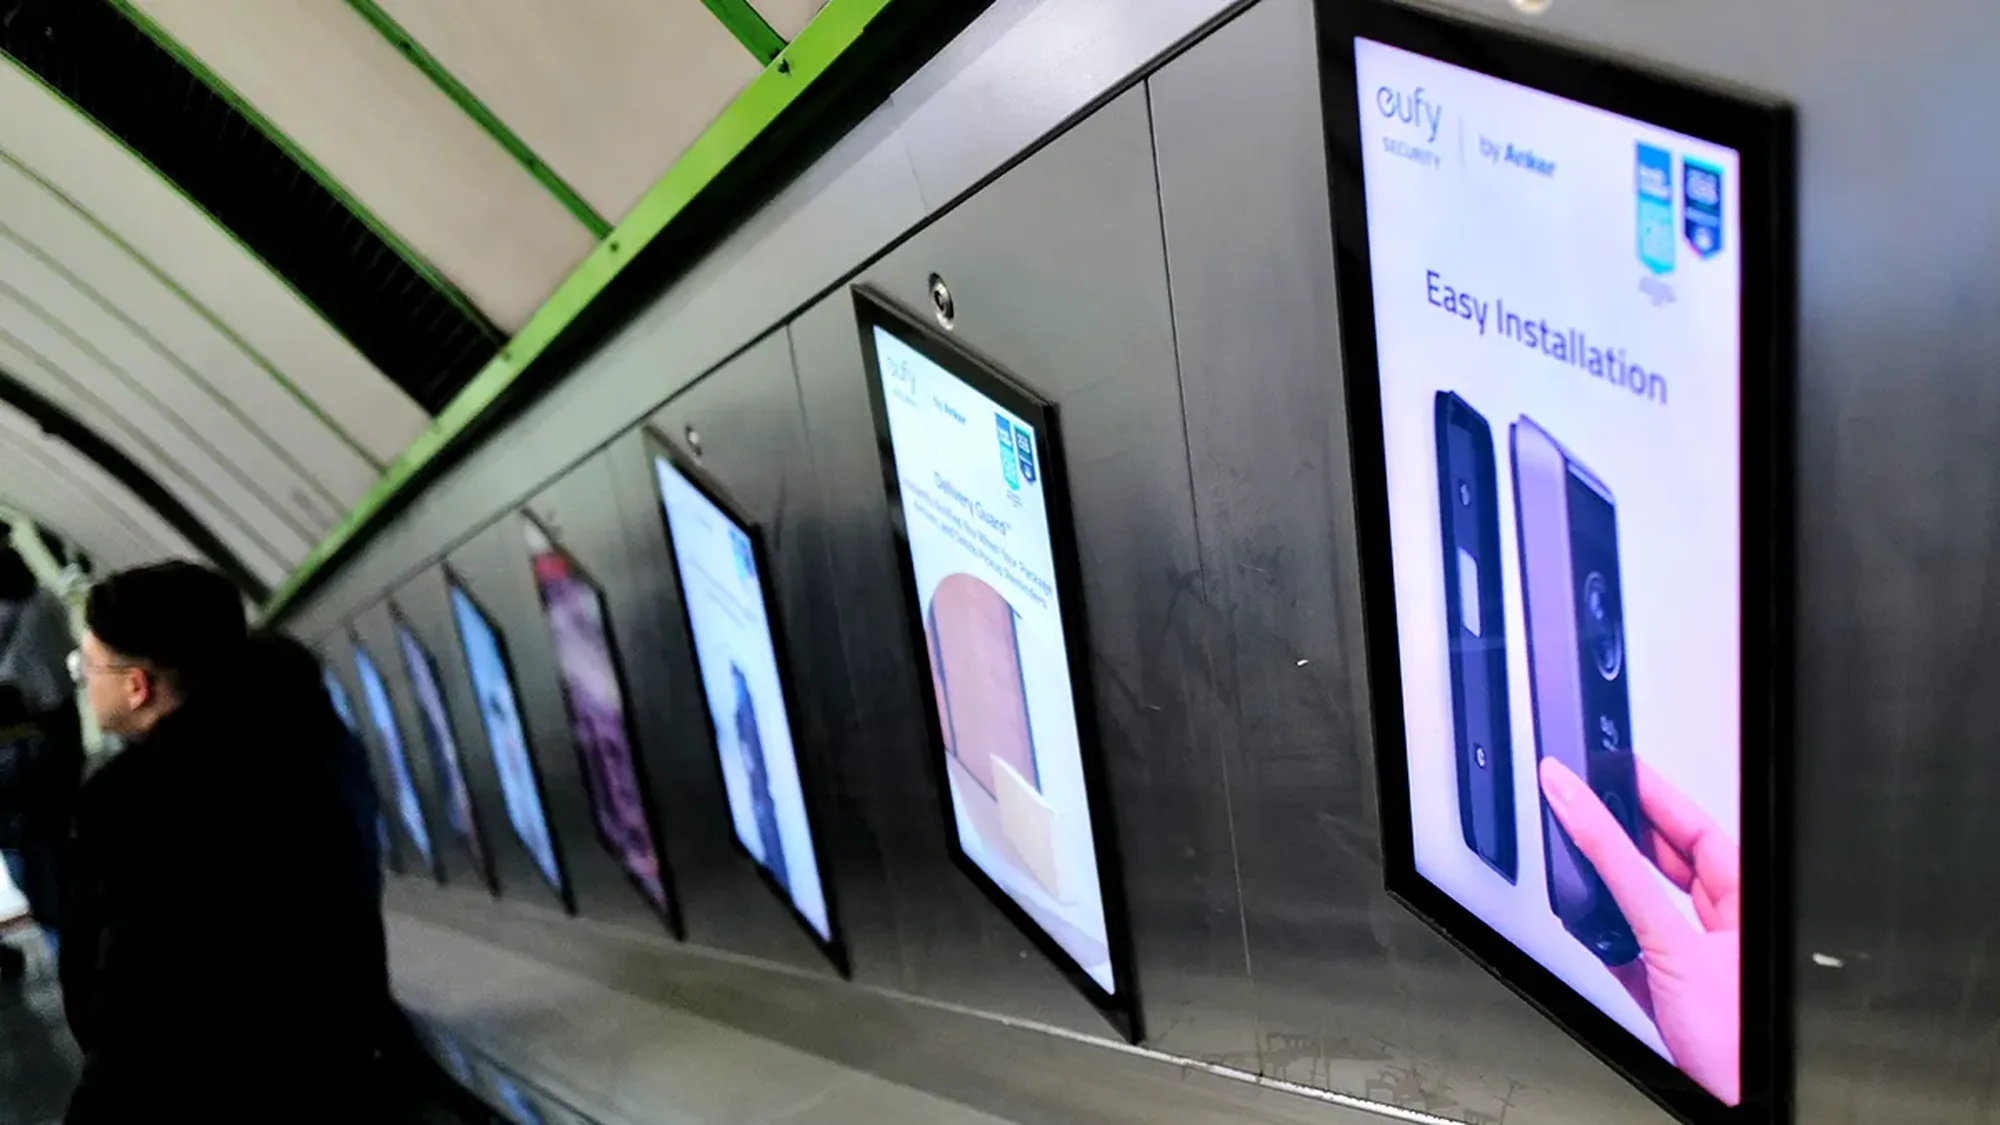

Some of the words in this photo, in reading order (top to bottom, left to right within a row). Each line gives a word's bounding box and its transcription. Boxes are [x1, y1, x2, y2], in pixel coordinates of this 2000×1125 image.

[1376, 85, 1442, 144] eufy
[1479, 133, 1501, 165] by
[1504, 142, 1557, 179] Anker
[1426, 269, 1488, 336] Easy
[1496, 298, 1668, 406] Installation
